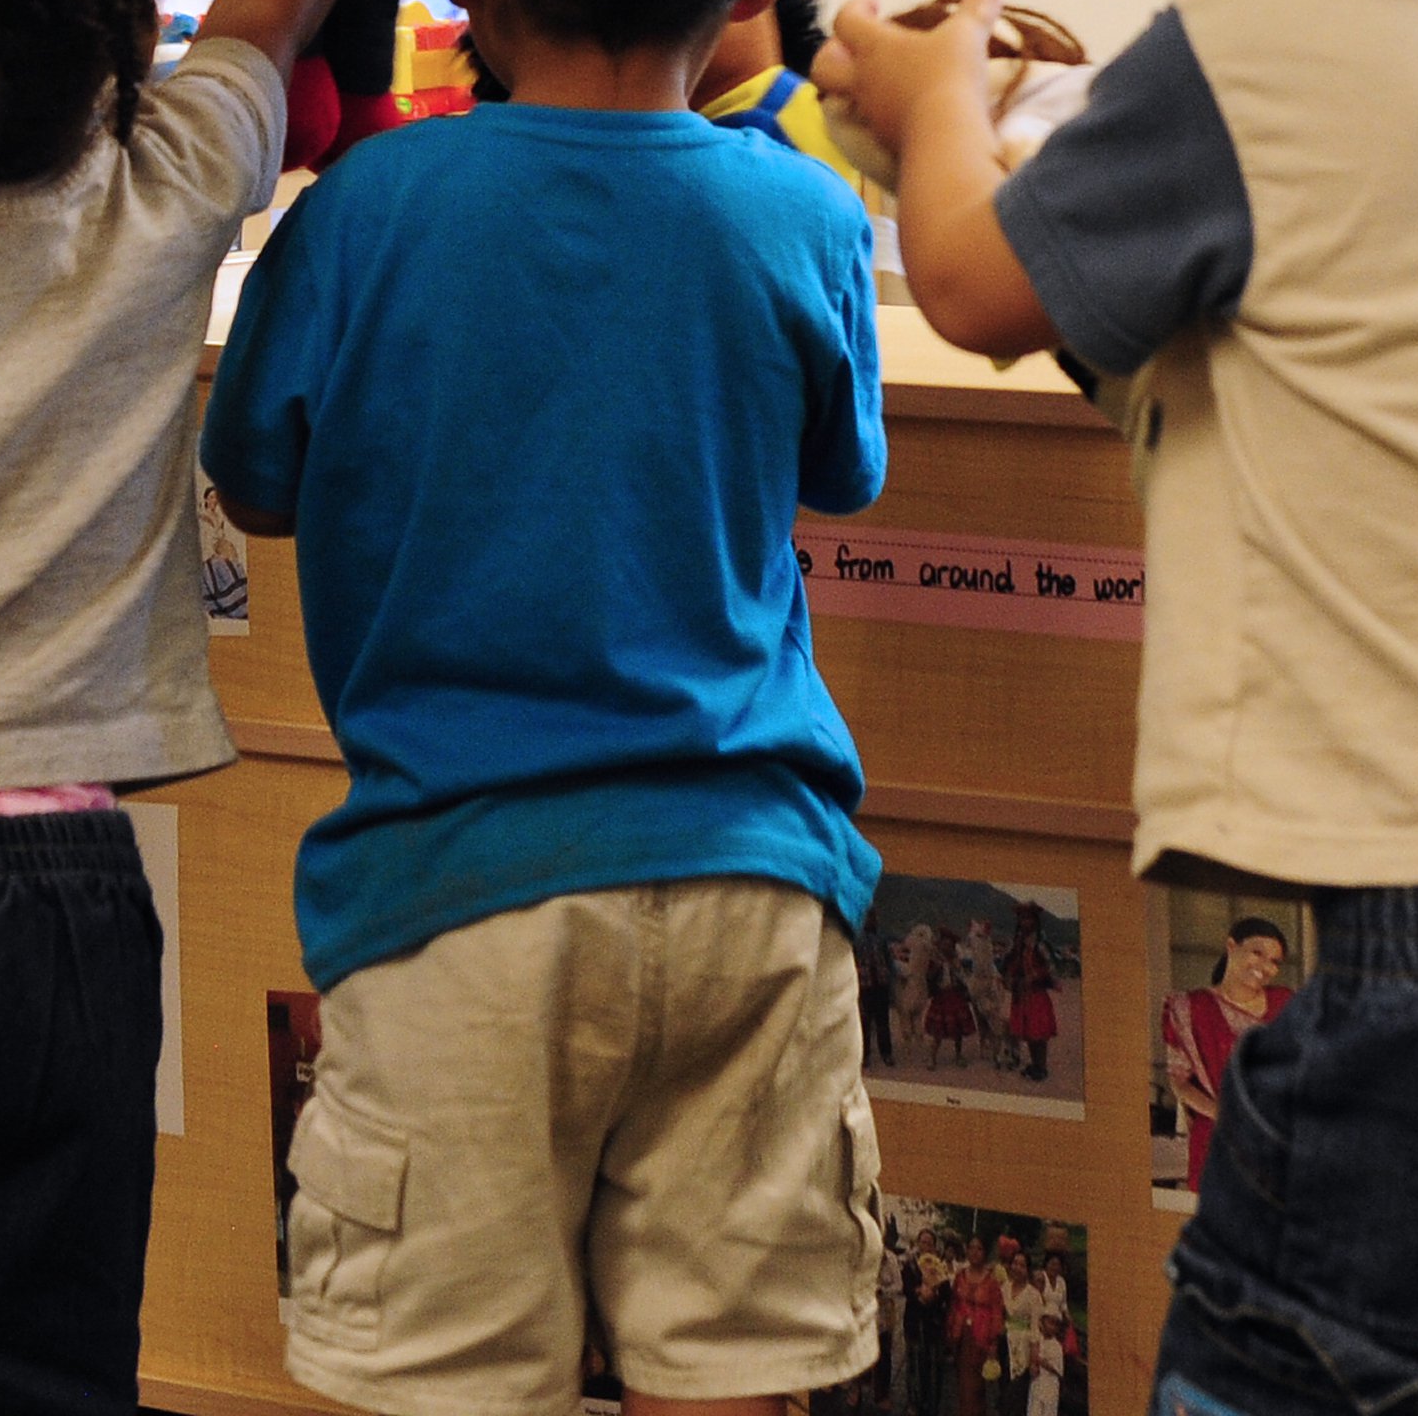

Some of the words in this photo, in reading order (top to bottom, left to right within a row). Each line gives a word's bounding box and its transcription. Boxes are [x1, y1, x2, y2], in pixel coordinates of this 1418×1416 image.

[835, 544, 895, 581] from
[919, 560, 1015, 594] around
[1035, 561, 1077, 597] the
